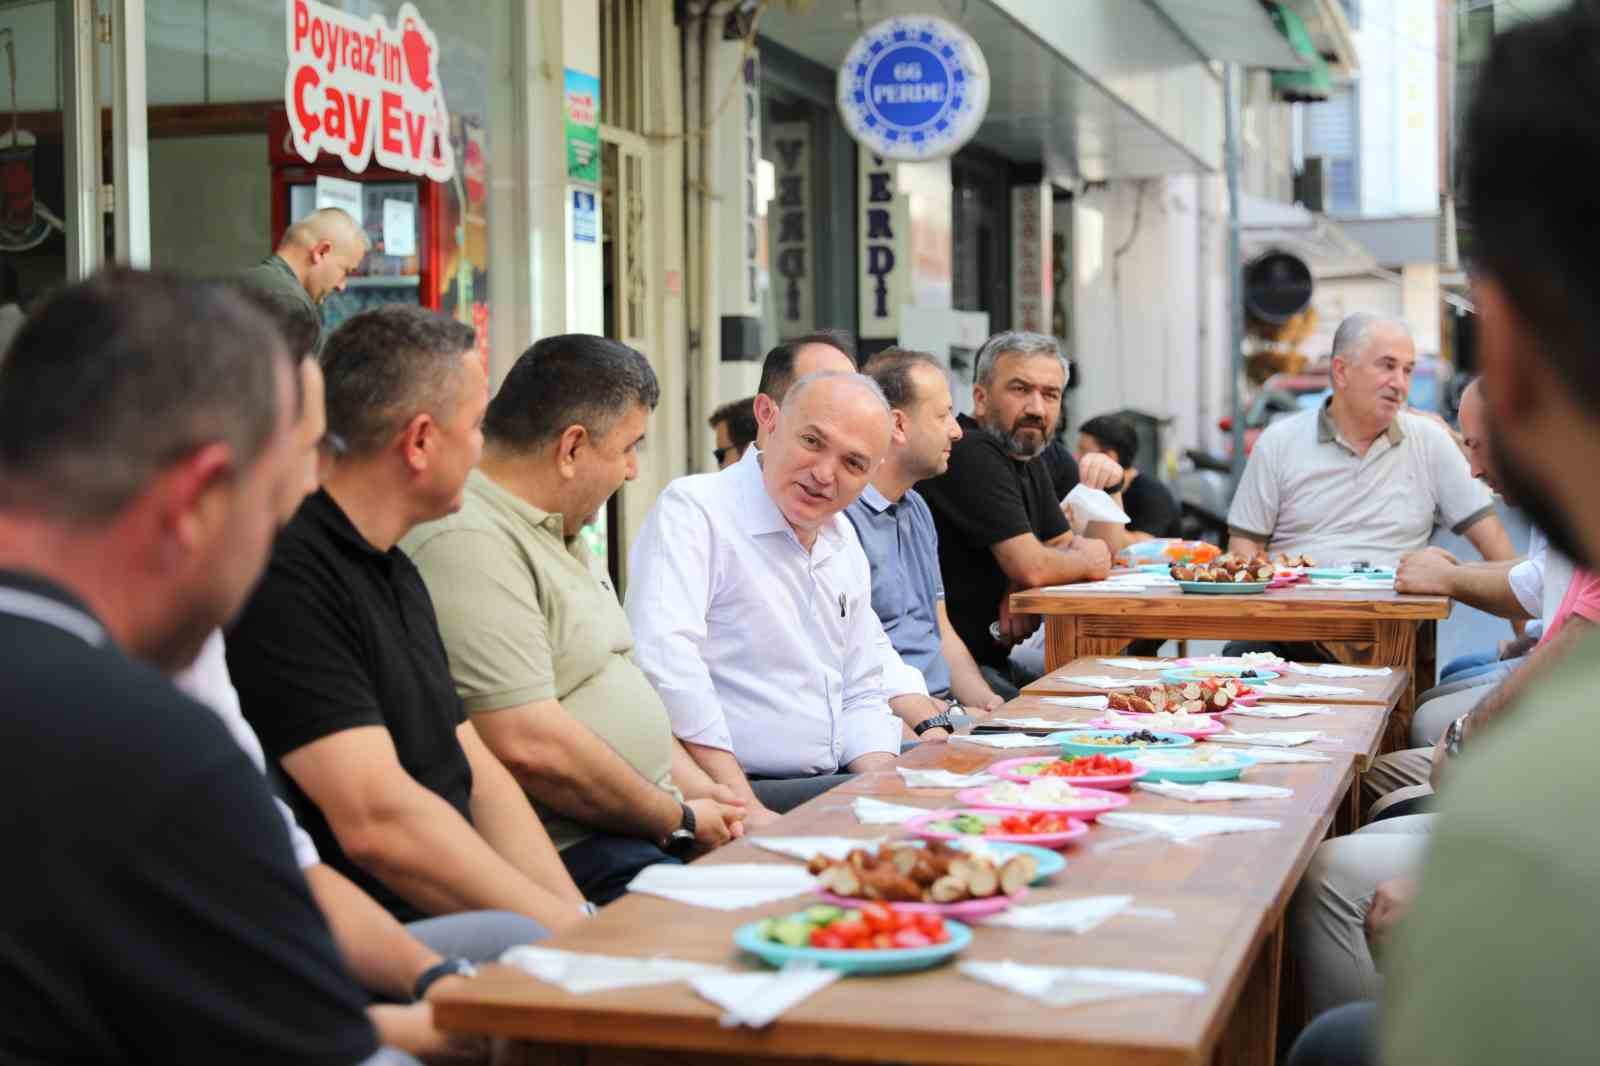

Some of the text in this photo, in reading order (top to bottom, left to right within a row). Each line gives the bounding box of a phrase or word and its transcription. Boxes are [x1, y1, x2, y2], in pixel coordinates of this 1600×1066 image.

[293, 65, 370, 157] Çay
[873, 82, 946, 104] PERDE
[866, 153, 895, 318] ERDİ
